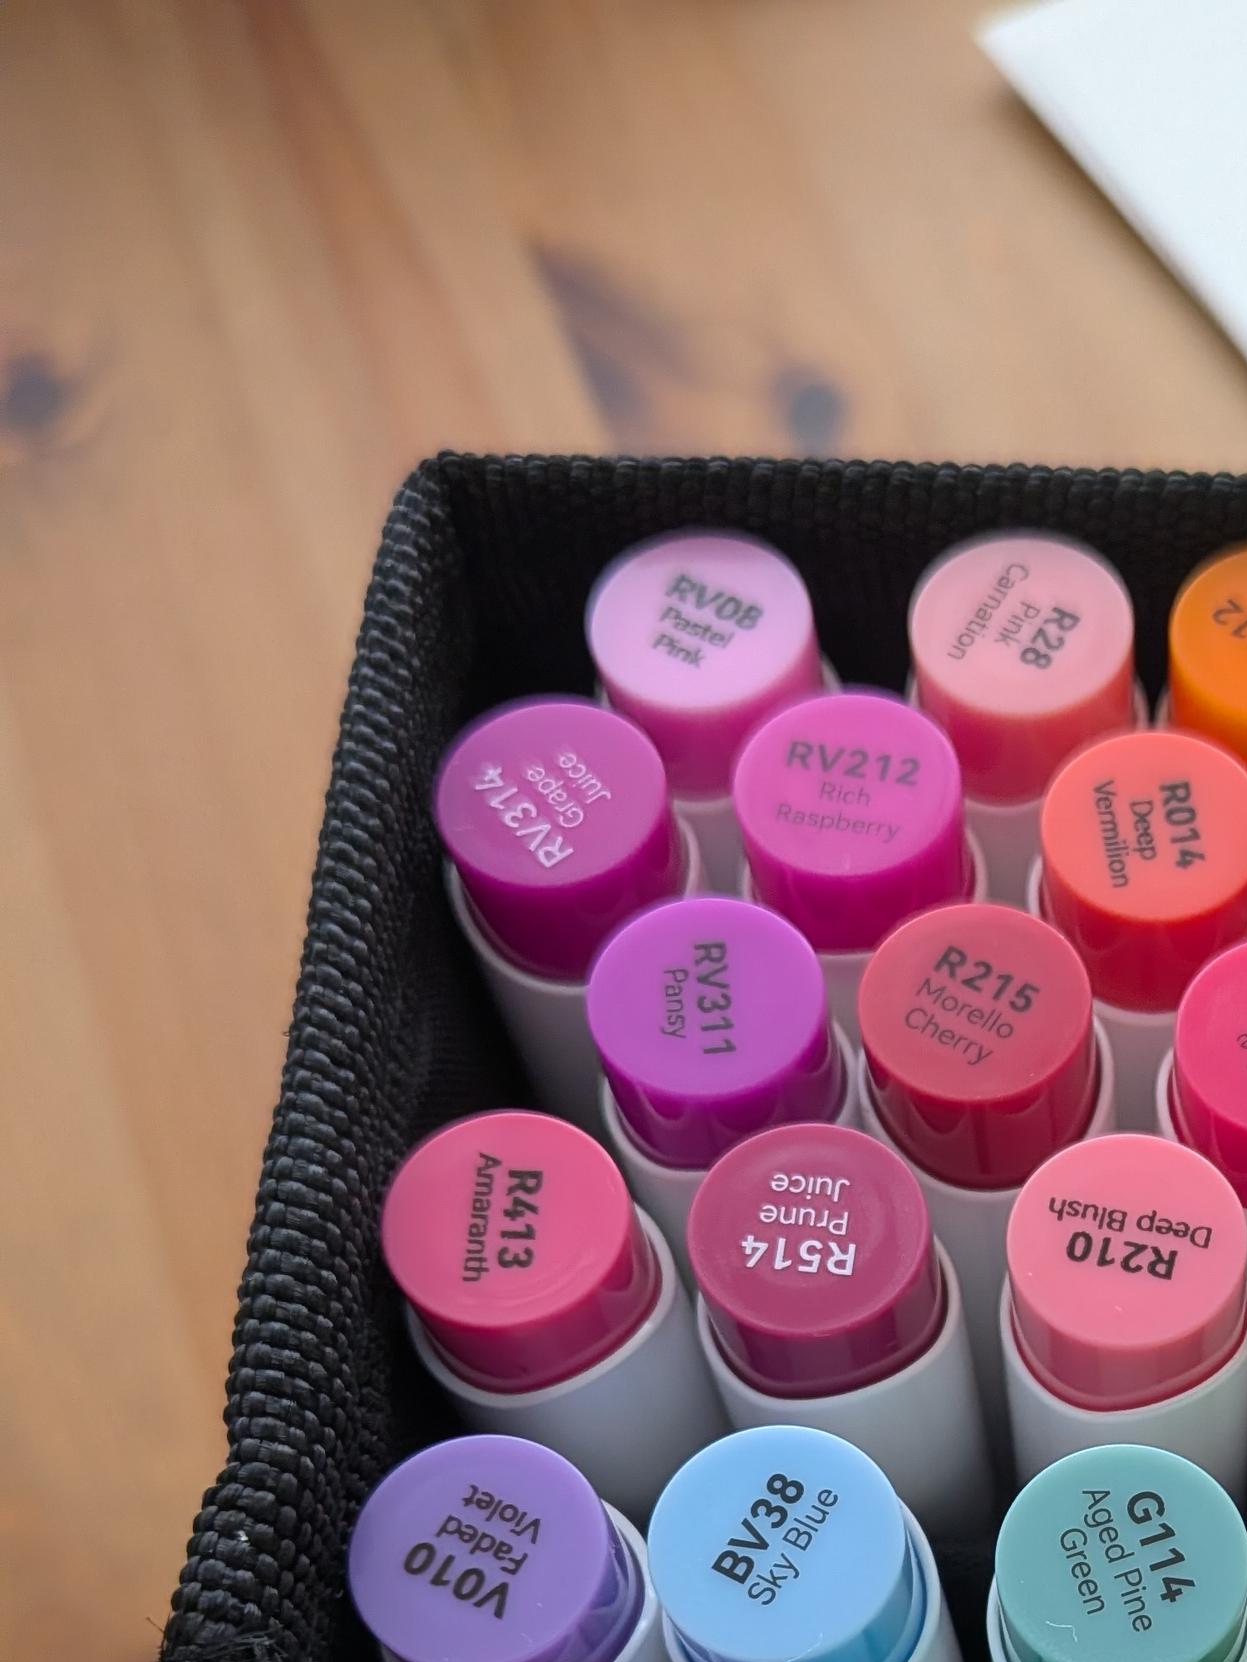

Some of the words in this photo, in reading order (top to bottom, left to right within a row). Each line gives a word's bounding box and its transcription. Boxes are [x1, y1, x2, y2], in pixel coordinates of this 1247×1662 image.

[659, 605, 735, 649] Pastel
[665, 574, 763, 630] RV08
[947, 561, 1030, 661] Carnation
[994, 601, 1042, 646] Pink
[651, 633, 706, 668] Pink
[1019, 605, 1081, 671] R28
[557, 749, 612, 803] Juice
[786, 740, 920, 787] RV212
[818, 780, 872, 809] Rich
[474, 762, 574, 868] RV314
[525, 763, 585, 829] Grape
[774, 802, 902, 844] Raspberry
[1159, 781, 1206, 870] R014
[1092, 780, 1129, 889] Vermilion
[1130, 800, 1157, 861] Deep
[660, 968, 689, 1041] Pansy
[693, 941, 739, 1056] RV311
[914, 976, 1016, 1041] Morello
[932, 945, 1042, 1015] R215
[904, 1007, 994, 1067] Cherry
[461, 1151, 502, 1283] Amaranth
[497, 1167, 543, 1270] R413
[770, 1172, 851, 1202] Juice
[1047, 1196, 1129, 1234] Blush
[759, 1203, 849, 1236] Prune
[1135, 1209, 1214, 1250] Deep
[740, 1233, 857, 1277] R514
[1065, 1229, 1179, 1282] R210
[436, 1514, 529, 1577] Faded
[462, 1483, 542, 1545] Violet
[711, 1471, 806, 1585] BV38
[1126, 1489, 1197, 1603] G114
[747, 1552, 801, 1607] Sky
[782, 1488, 840, 1553] Blue
[1059, 1526, 1106, 1616] Green
[1081, 1488, 1135, 1565] Aged
[1112, 1565, 1154, 1634] Pine
[402, 1541, 511, 1621] V010
